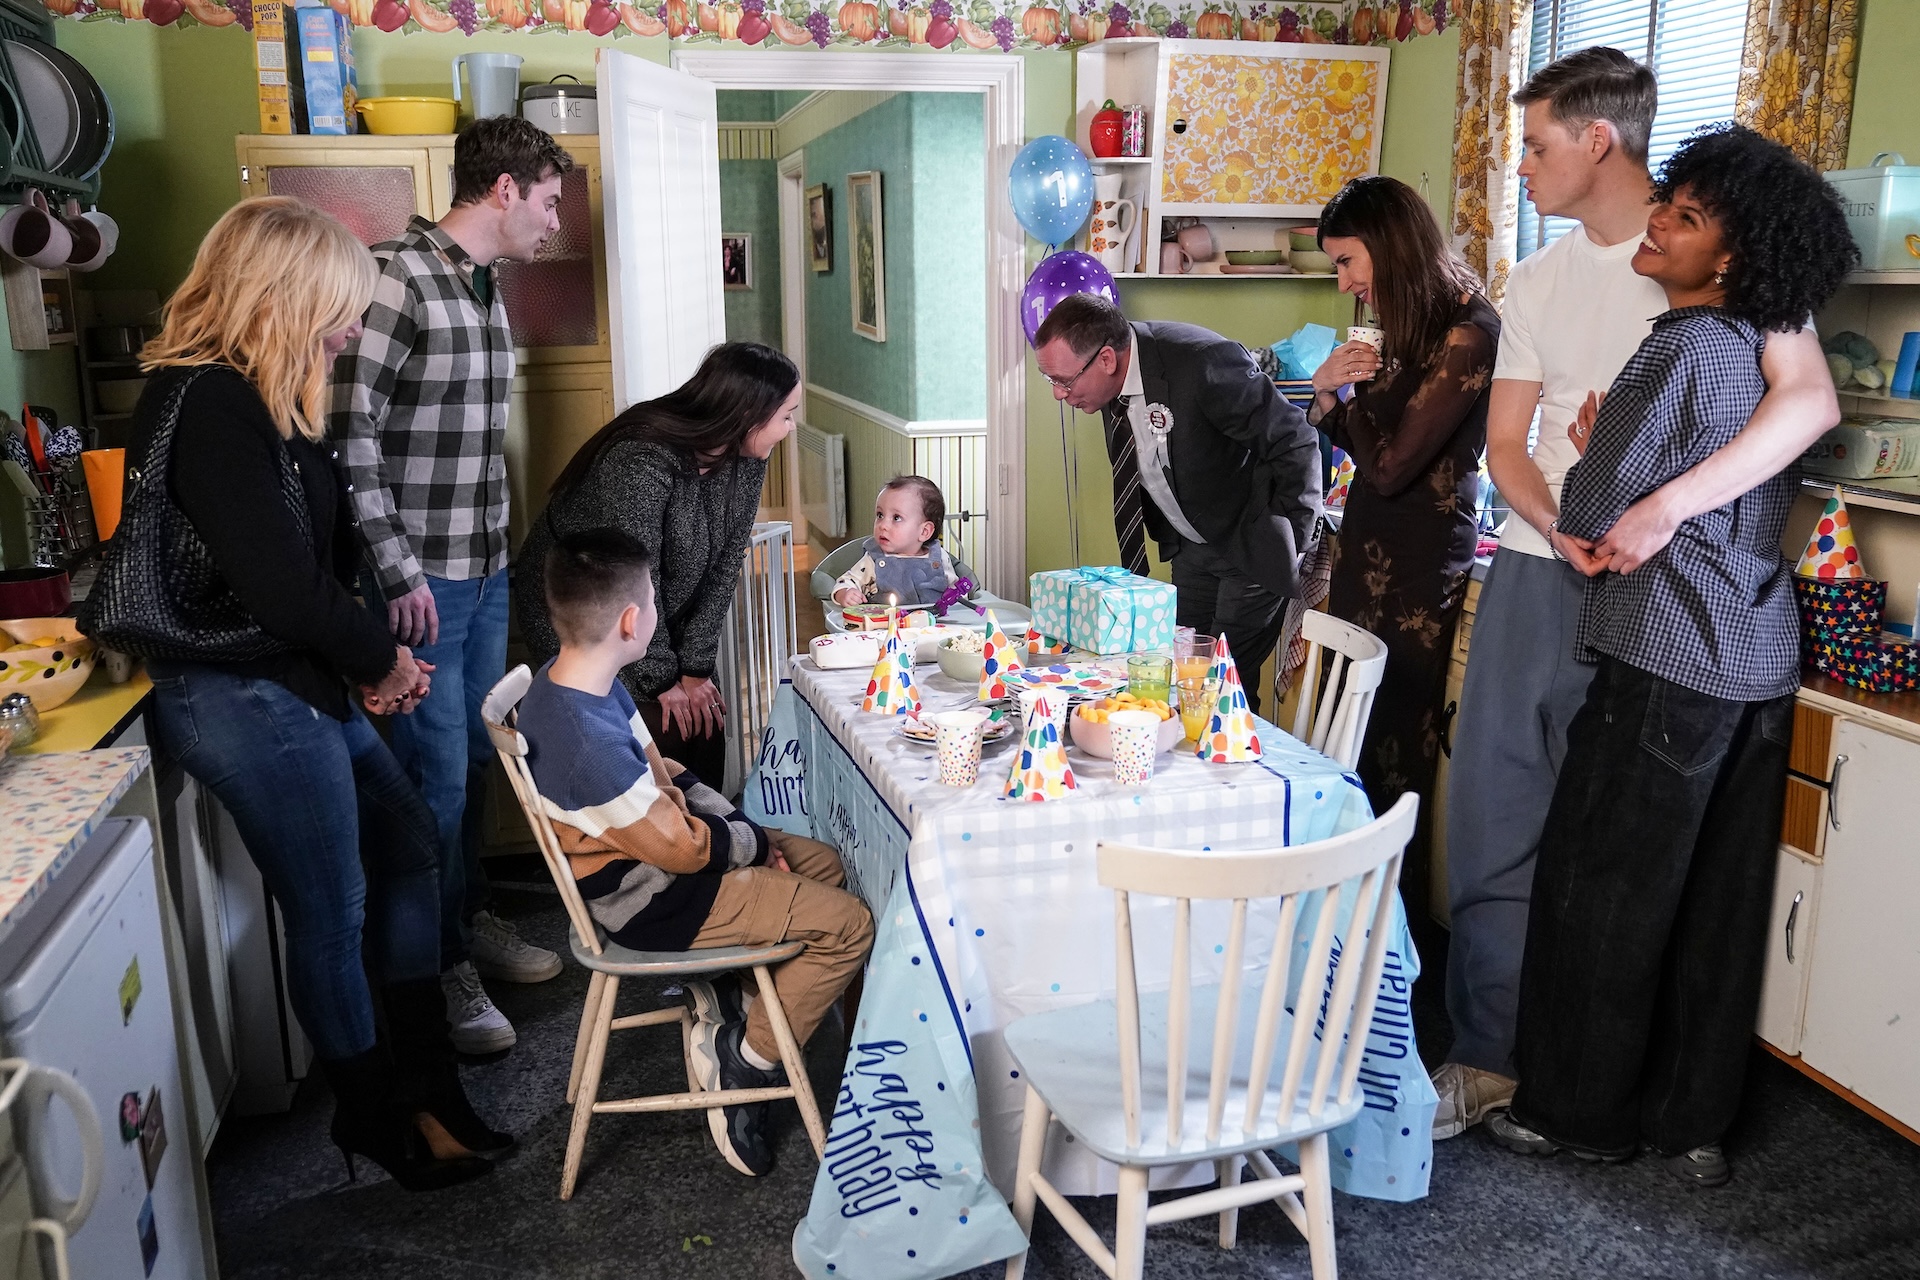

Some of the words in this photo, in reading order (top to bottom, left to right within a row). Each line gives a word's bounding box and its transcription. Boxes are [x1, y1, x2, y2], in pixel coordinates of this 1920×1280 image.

[253, 2, 281, 13] CHOCCO
[260, 12, 278, 21] POPS
[550, 101, 582, 118] CAKE
[1048, 170, 1068, 208] 1
[1842, 202, 1875, 217] CUITS
[854, 1039, 943, 1191] happy
